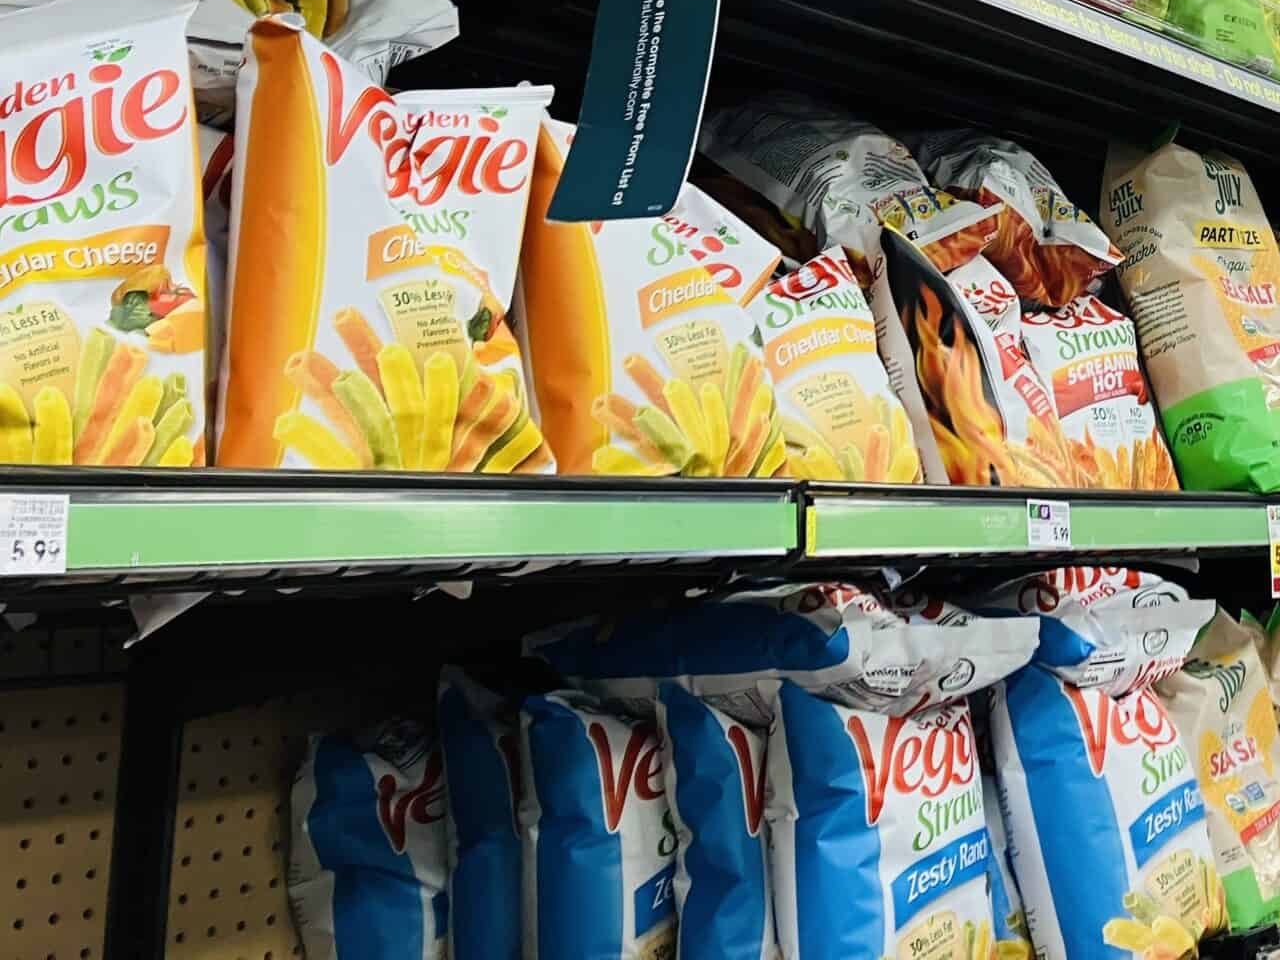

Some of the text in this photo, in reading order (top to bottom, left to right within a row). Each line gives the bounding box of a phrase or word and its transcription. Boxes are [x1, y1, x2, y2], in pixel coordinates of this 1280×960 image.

[652, 11, 666, 33] the
[641, 37, 662, 100] complete
[0, 72, 75, 119] den
[634, 102, 652, 132] Free
[0, 64, 189, 208] gie
[625, 134, 645, 167] From
[617, 166, 635, 190] List
[1214, 173, 1243, 216] JULY
[1109, 179, 1134, 213] LATE
[1114, 194, 1144, 228] JULY
[1199, 228, 1235, 245] PART
[63, 241, 157, 270] Cheese
[12, 306, 61, 331] Less Fat
[774, 324, 875, 368] Cheddar Che
[1092, 370, 1125, 392] HOT
[1089, 406, 1117, 421] 30%
[1129, 407, 1143, 420] NO
[847, 709, 976, 826] Vegg
[1210, 745, 1237, 778] SEA
[1146, 800, 1184, 844] Zesty
[907, 851, 957, 904] Zesty
